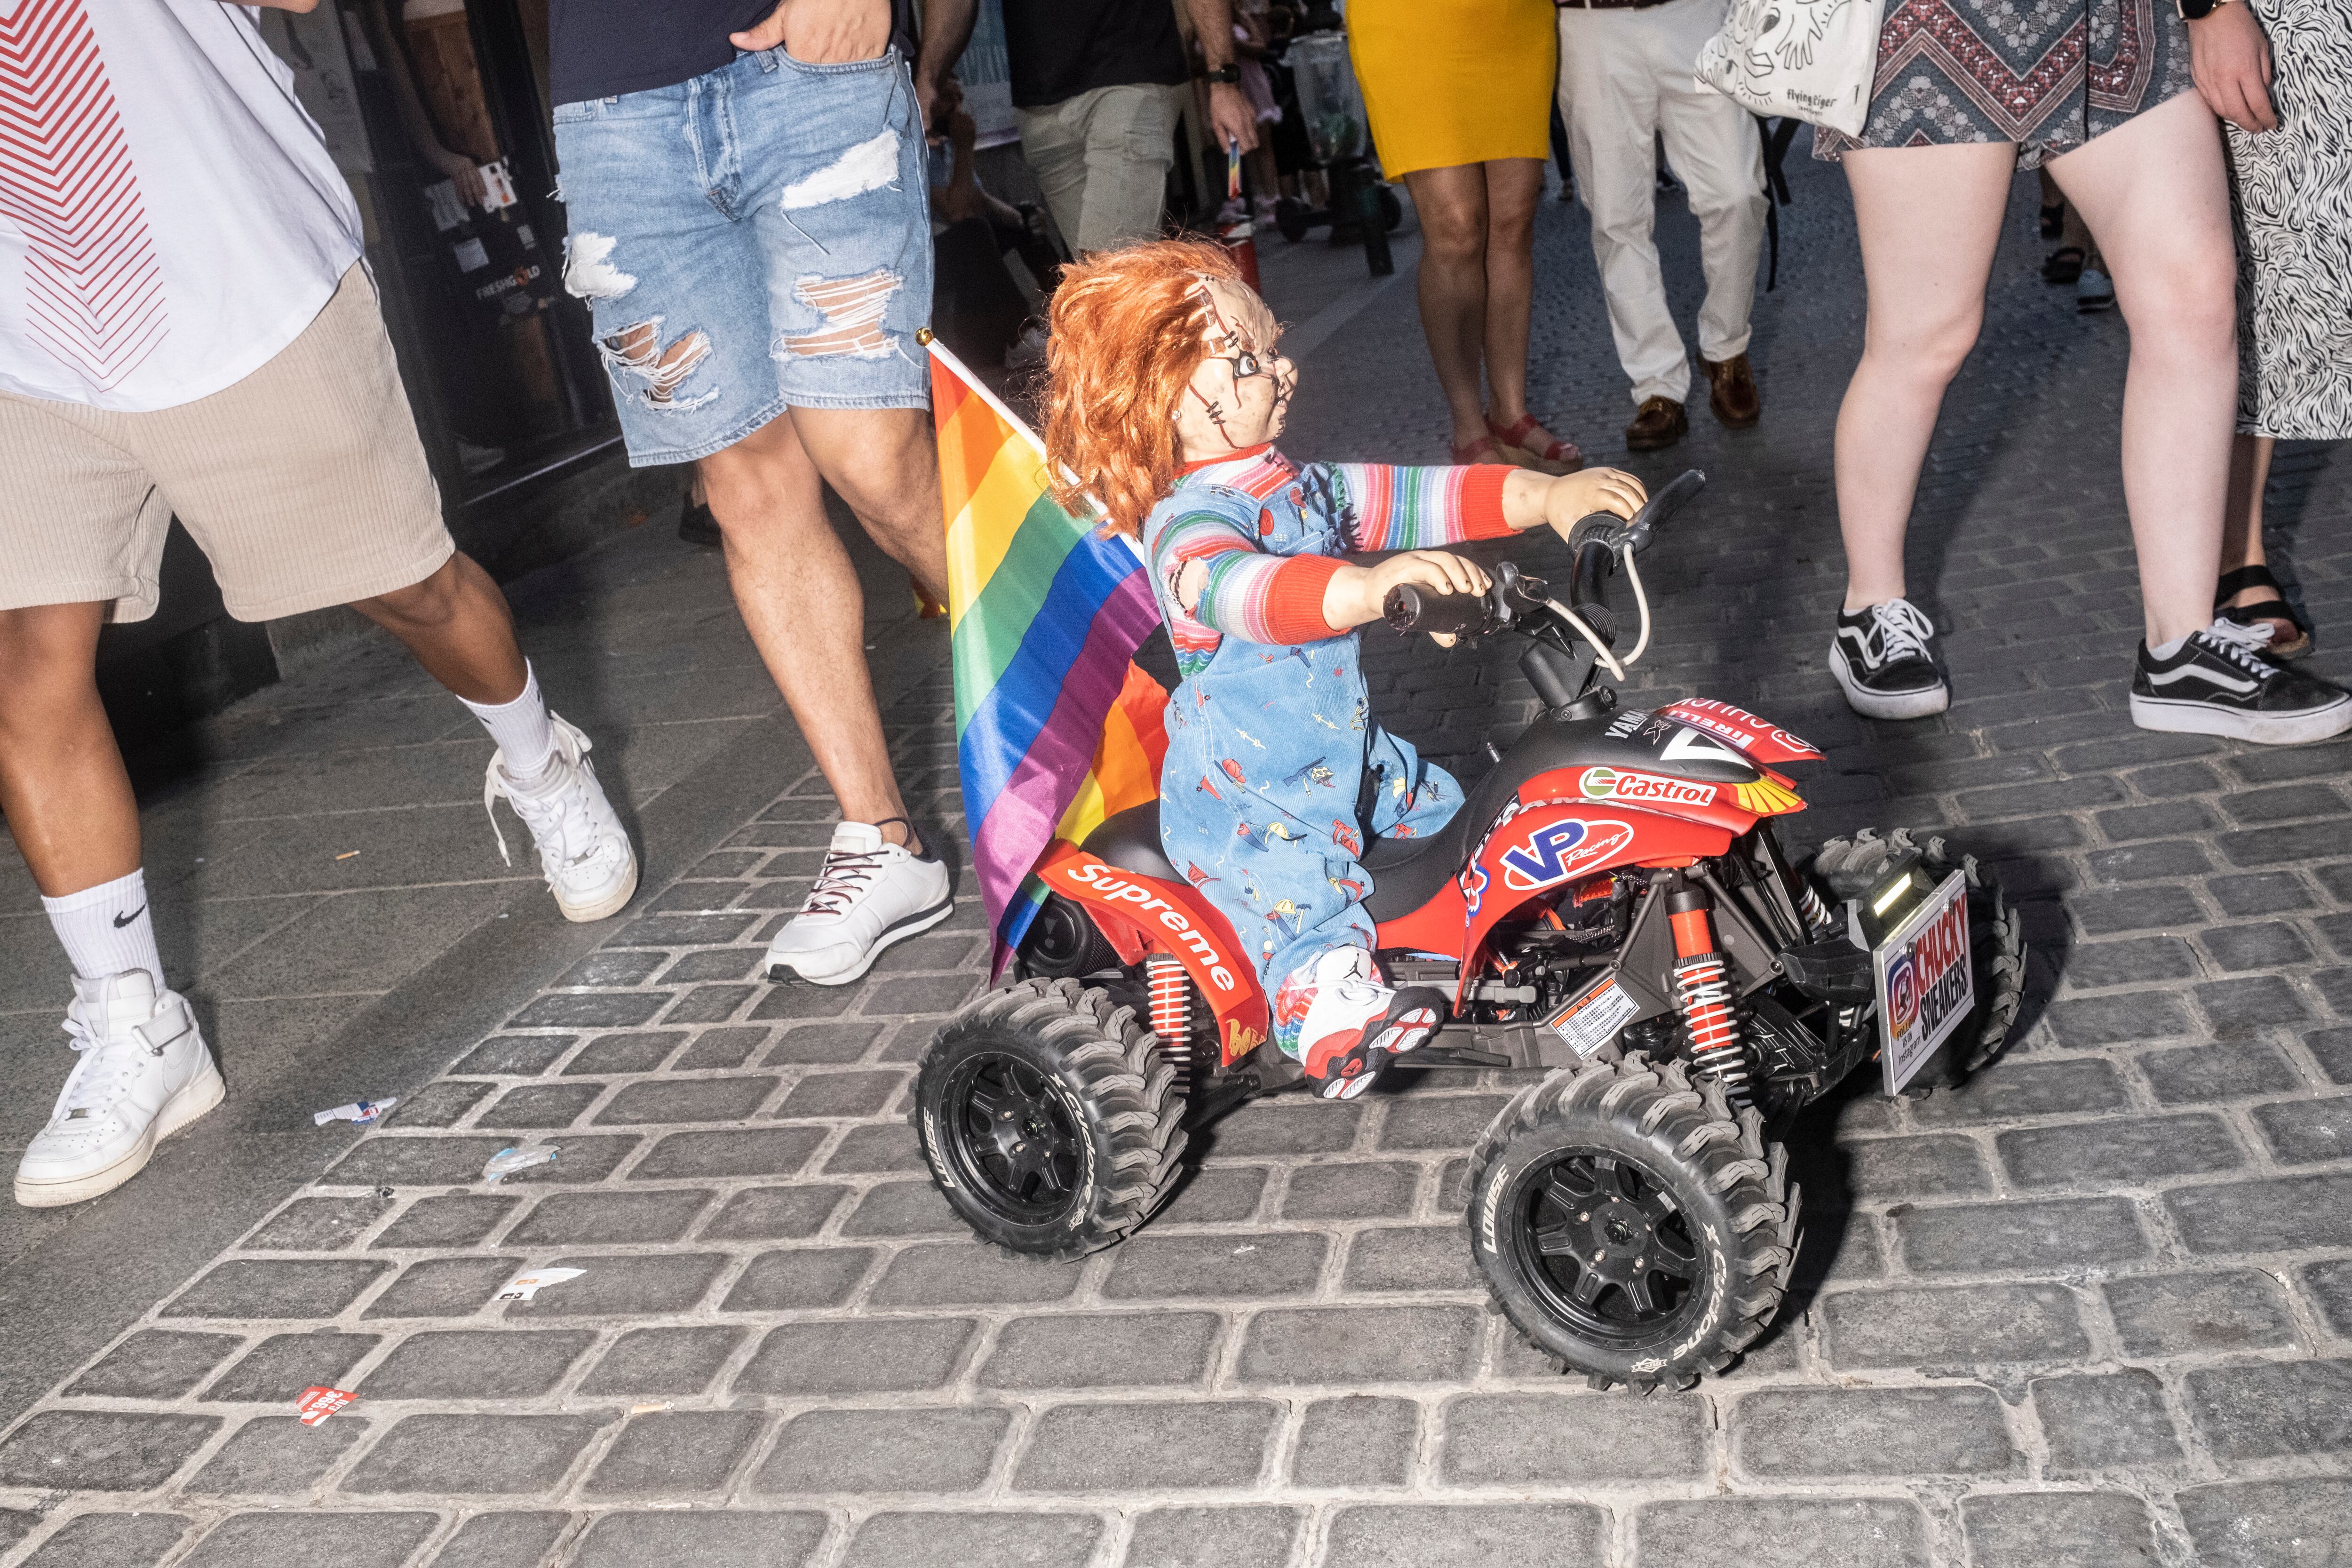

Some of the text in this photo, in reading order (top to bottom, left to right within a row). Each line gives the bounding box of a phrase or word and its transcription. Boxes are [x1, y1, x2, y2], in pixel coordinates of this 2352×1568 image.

[1616, 775, 1711, 804] Castrol
[1504, 821, 1585, 882] VP
[1565, 829, 1629, 867] Racing
[1067, 864, 1235, 991] Supreme
[1915, 892, 1967, 996] CHUCKY
[1897, 1014, 1916, 1042] FOLLOW
[1920, 953, 1968, 1041] SNEAKERS
[1898, 1036, 1921, 1066] Instagram
[1902, 1030, 1912, 1048] US ON
[924, 1106, 956, 1187] LOUISE
[1483, 1163, 1509, 1254] LOUISE
